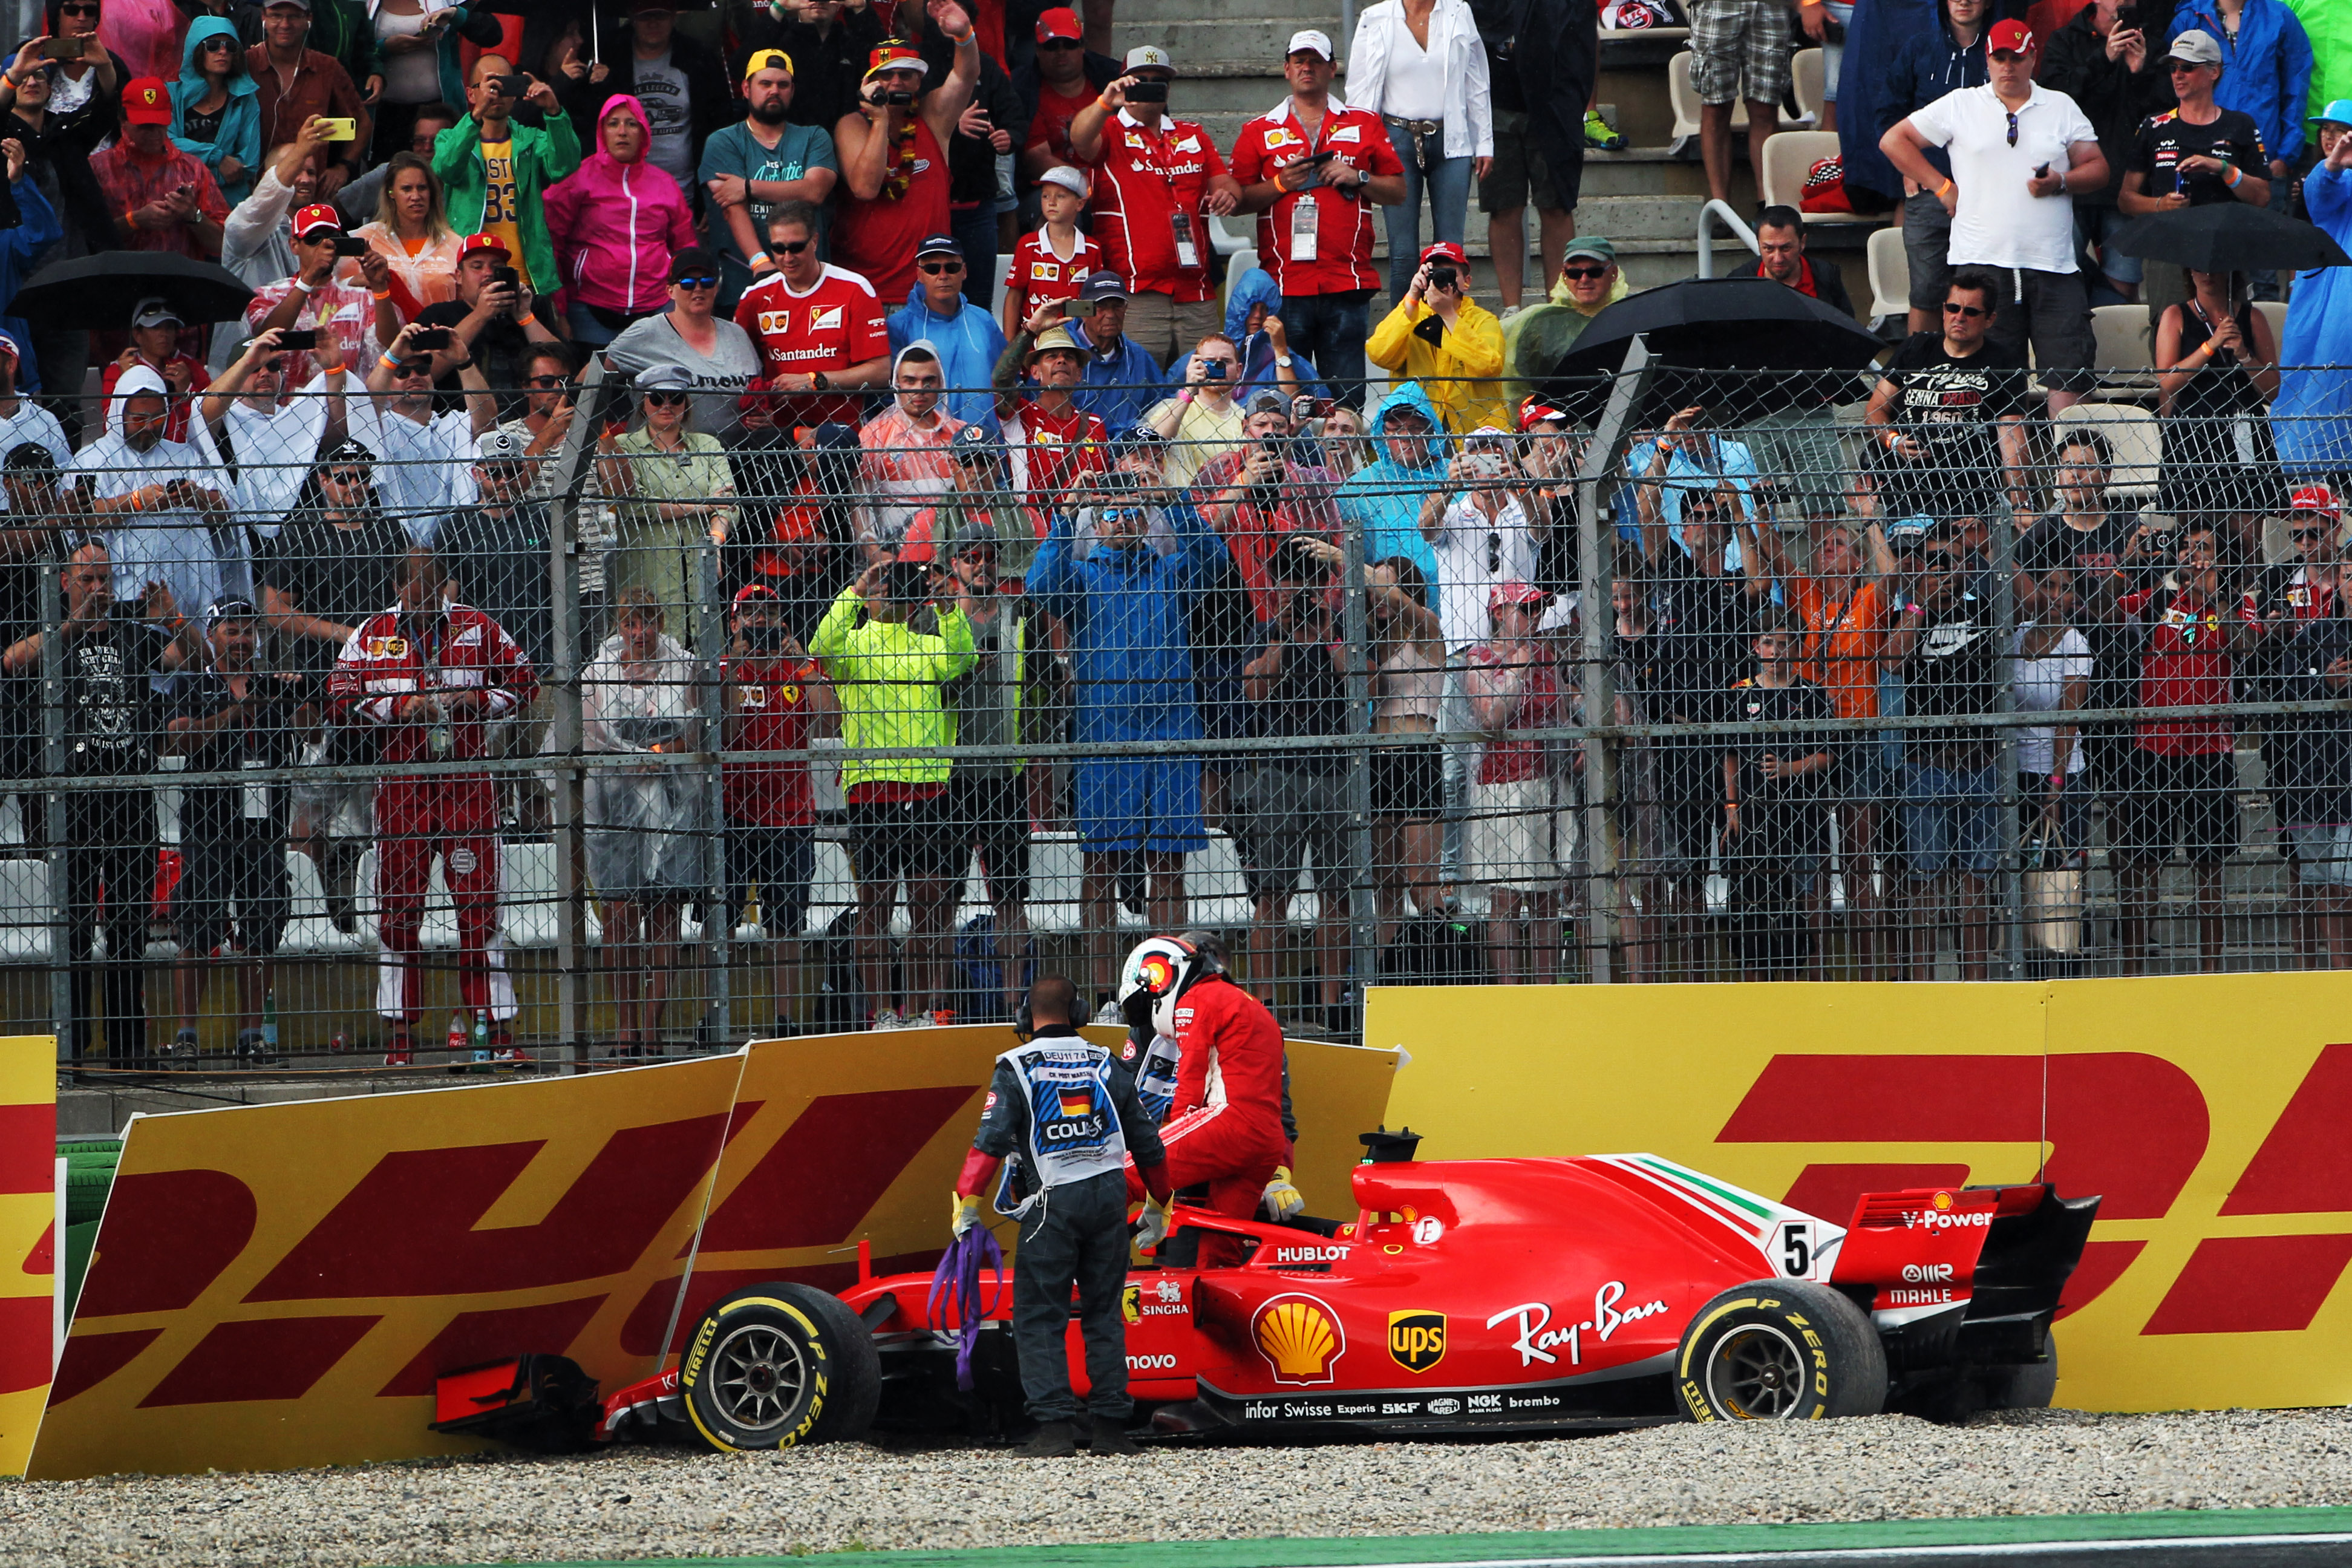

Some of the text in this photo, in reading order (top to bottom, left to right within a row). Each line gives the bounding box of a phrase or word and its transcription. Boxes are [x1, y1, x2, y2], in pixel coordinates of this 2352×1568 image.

[776, 318, 786, 328] ups
[774, 342, 837, 362] Santander
[1904, 390, 1939, 406] SENNA
[388, 642, 405, 656] ups
[1901, 1210, 1993, 1229] V-Power
[1277, 1245, 1351, 1262] HUBLOT
[1784, 1224, 1809, 1276] 5
[1890, 1289, 1952, 1304] MAHLE
[1142, 1304, 1189, 1316] SINGHA
[1486, 1281, 1670, 1368] Ray-Ban
[682, 1316, 719, 1387] PIRELLI
[1392, 1327, 1443, 1363] ups
[1757, 1298, 1828, 1397] P ZERO
[1125, 1354, 1177, 1370] novo
[778, 1341, 828, 1450] P ZERO
[1467, 1394, 1561, 1408] NGK brembo
[1245, 1401, 1420, 1419] infor Swisse Experis SKF
